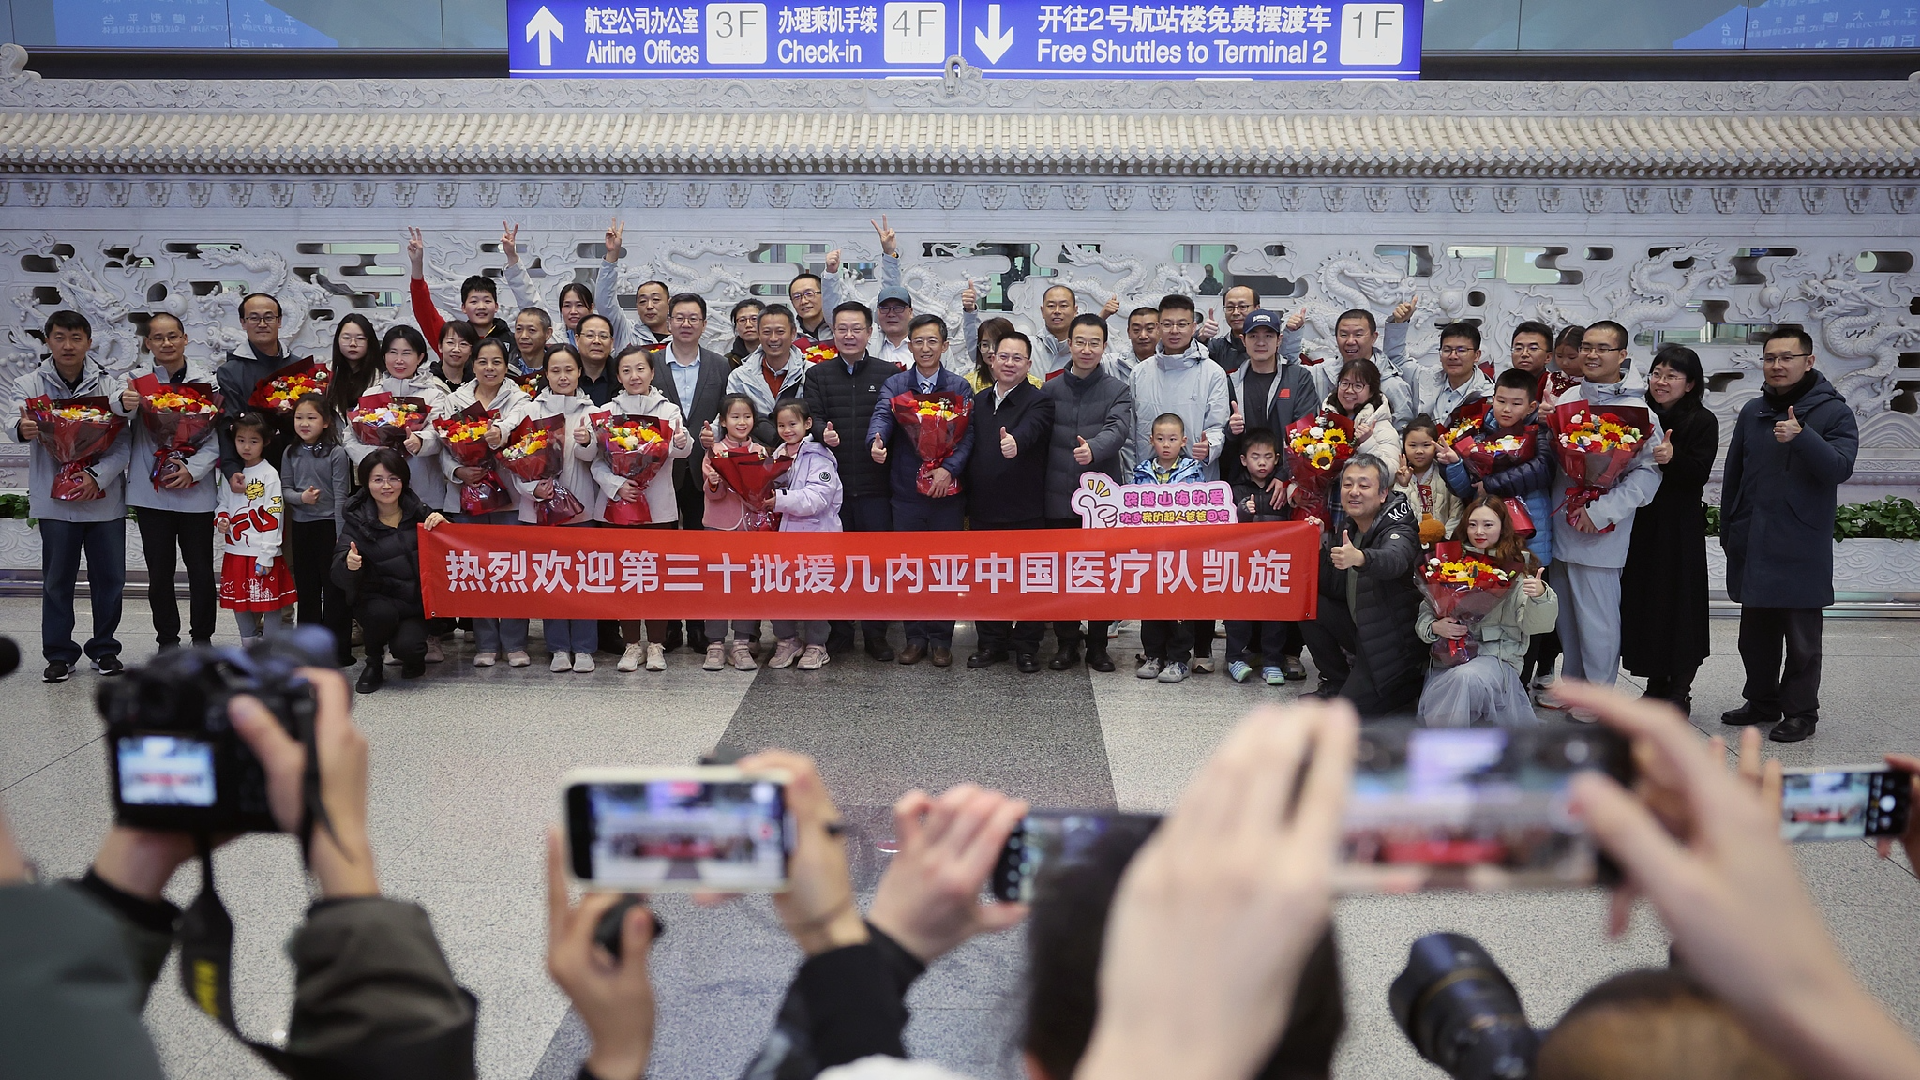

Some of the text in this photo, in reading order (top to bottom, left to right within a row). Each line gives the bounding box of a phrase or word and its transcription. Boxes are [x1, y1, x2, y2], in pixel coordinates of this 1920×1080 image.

[584, 6, 699, 35] 航空公司办公室
[715, 10, 759, 39] 3F
[777, 5, 878, 34] 办理乘机手续
[892, 9, 938, 37] 4F
[1037, 4, 1332, 34] 开往2号航站楼免费摆渡车
[1352, 10, 1396, 39] 1F
[585, 39, 700, 65] Airline Offices
[777, 38, 863, 64] Check-in
[1037, 38, 1328, 64] Free Shuttles to Terminal 2
[1123, 488, 1225, 508] 跨越山海的爱
[1119, 508, 1230, 524] 欢迎我的超人爸爸回家
[445, 547, 1292, 598] 热烈欢迎第三十批援几内亚中国医疗队凯旋
